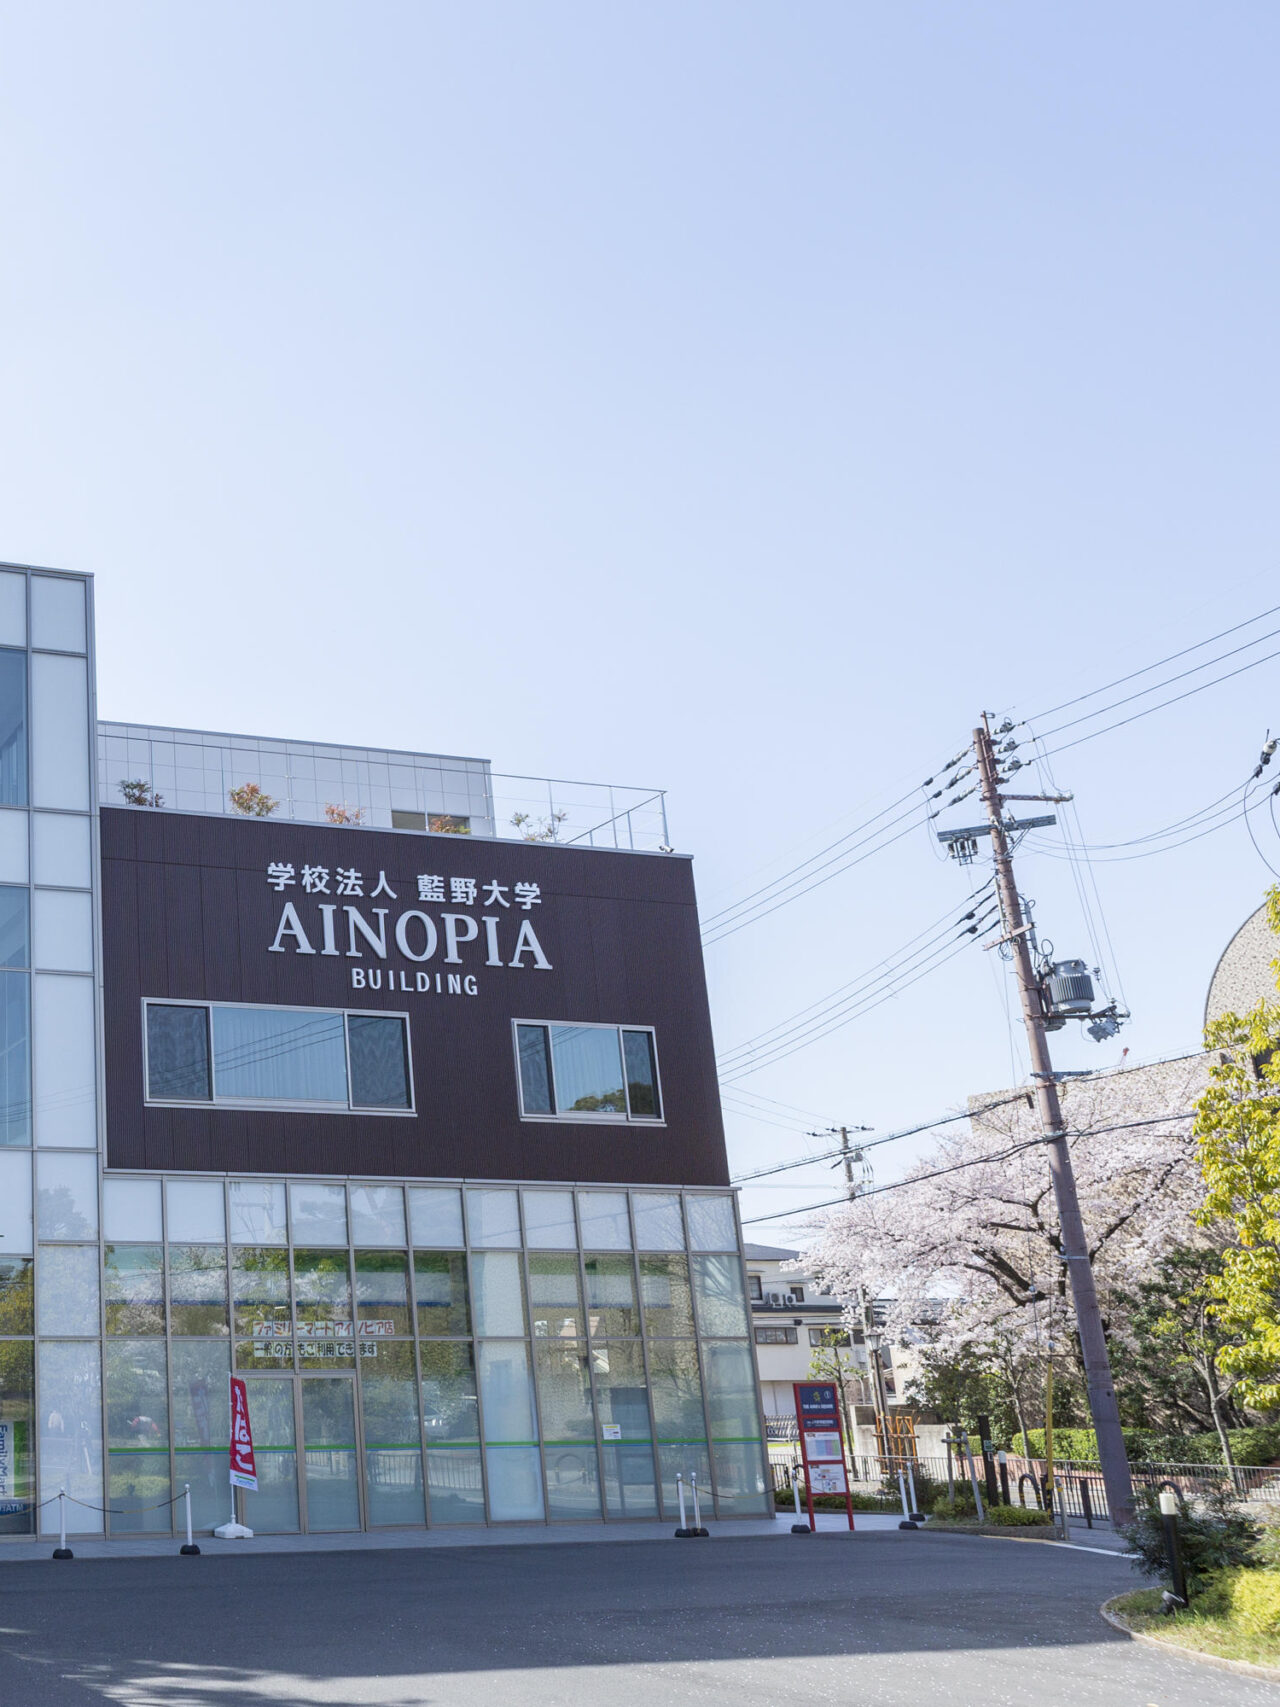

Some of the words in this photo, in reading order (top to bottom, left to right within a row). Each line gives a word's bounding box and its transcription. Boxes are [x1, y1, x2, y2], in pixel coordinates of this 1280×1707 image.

[267, 862, 398, 899] 学校法人
[417, 873, 542, 911] 藍野大学
[268, 901, 553, 970] AINOPIA
[351, 967, 478, 996] BUILDING
